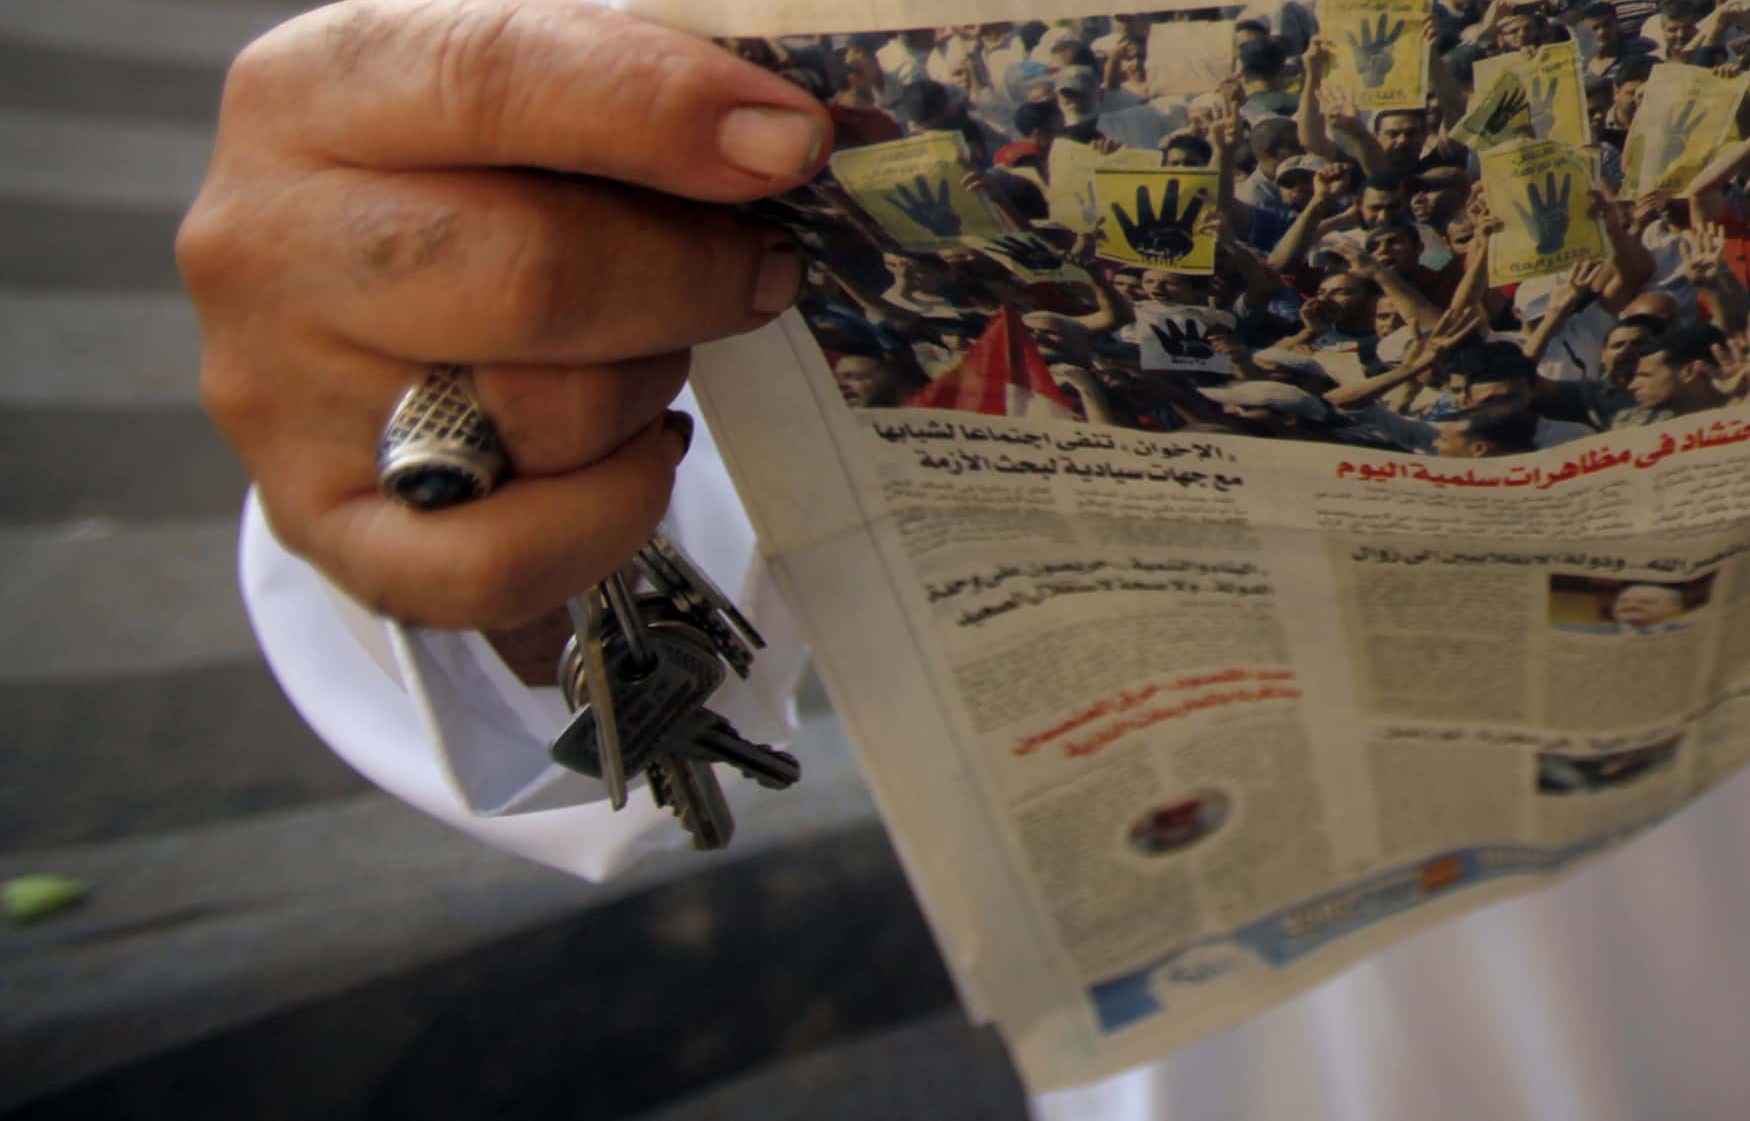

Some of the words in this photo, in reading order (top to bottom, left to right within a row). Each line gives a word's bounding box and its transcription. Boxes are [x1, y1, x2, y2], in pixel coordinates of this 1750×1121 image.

[872, 419, 955, 445] لشبابها
[957, 424, 1052, 450] اجتماعا
[1054, 430, 1116, 452] تنفى
[1632, 430, 1678, 471] فى
[993, 453, 1057, 481] لبحث
[1062, 456, 1145, 485] سيادية
[1147, 463, 1209, 489] جهات
[1335, 458, 1409, 485] اليوم
[1411, 461, 1503, 490] سلمية
[1503, 446, 1633, 492] مظاهرات
[1213, 471, 1245, 493] مع
